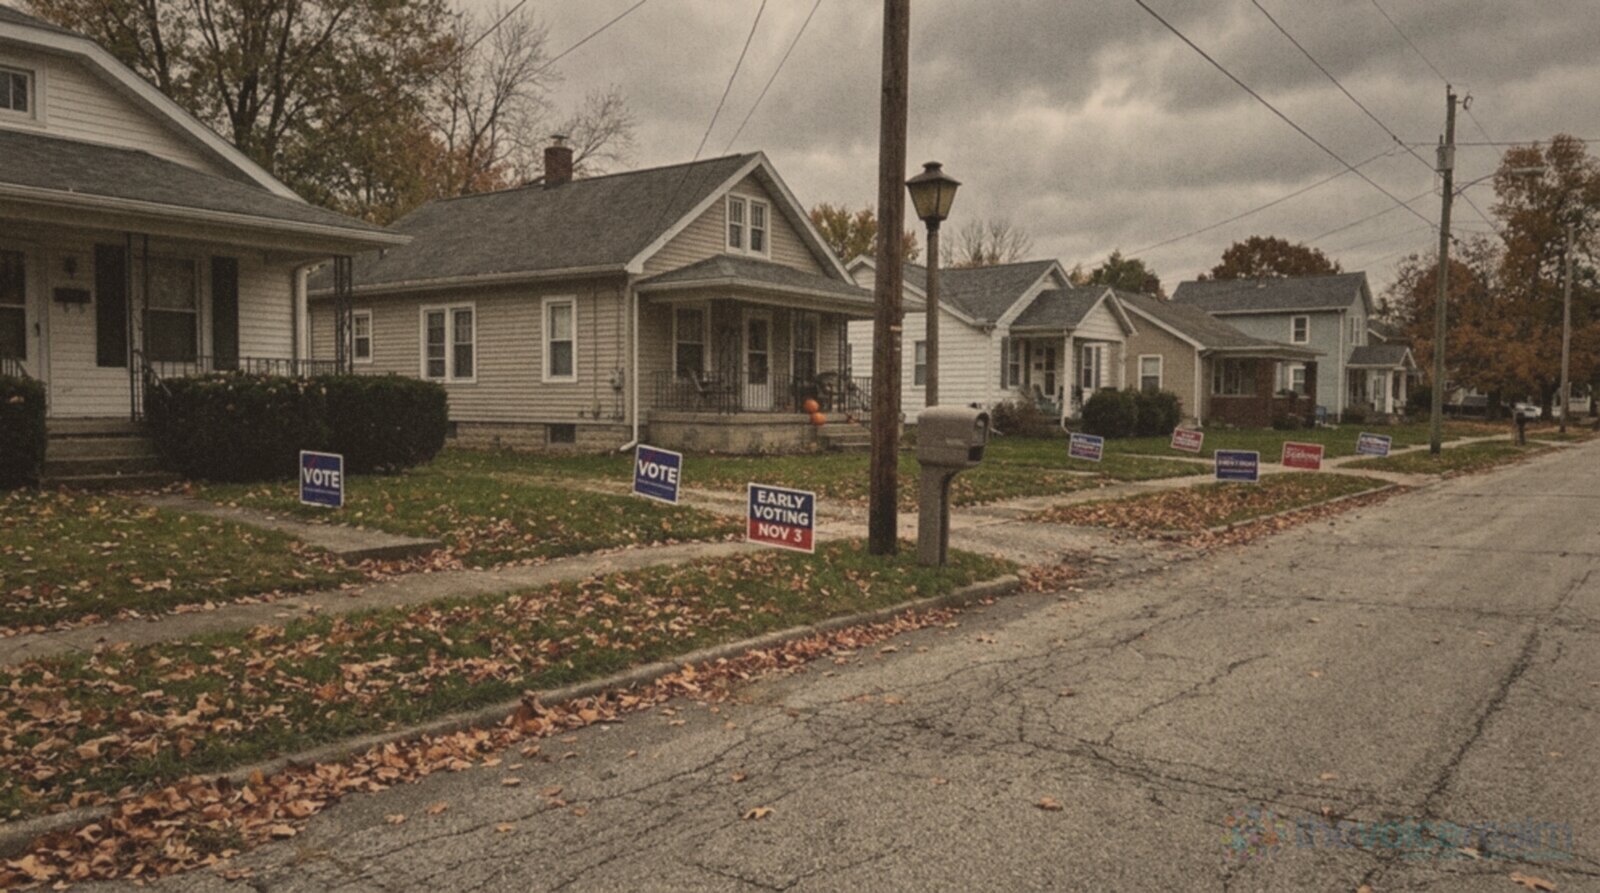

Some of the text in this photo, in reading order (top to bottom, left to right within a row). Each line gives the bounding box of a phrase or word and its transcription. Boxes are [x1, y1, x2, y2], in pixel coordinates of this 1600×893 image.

[303, 467, 340, 489] VOTE
[638, 459, 678, 484] VOTE
[757, 490, 805, 509] EARLY
[753, 504, 809, 526] VOTING
[758, 523, 790, 540] NOV
[793, 528, 803, 543] 3
